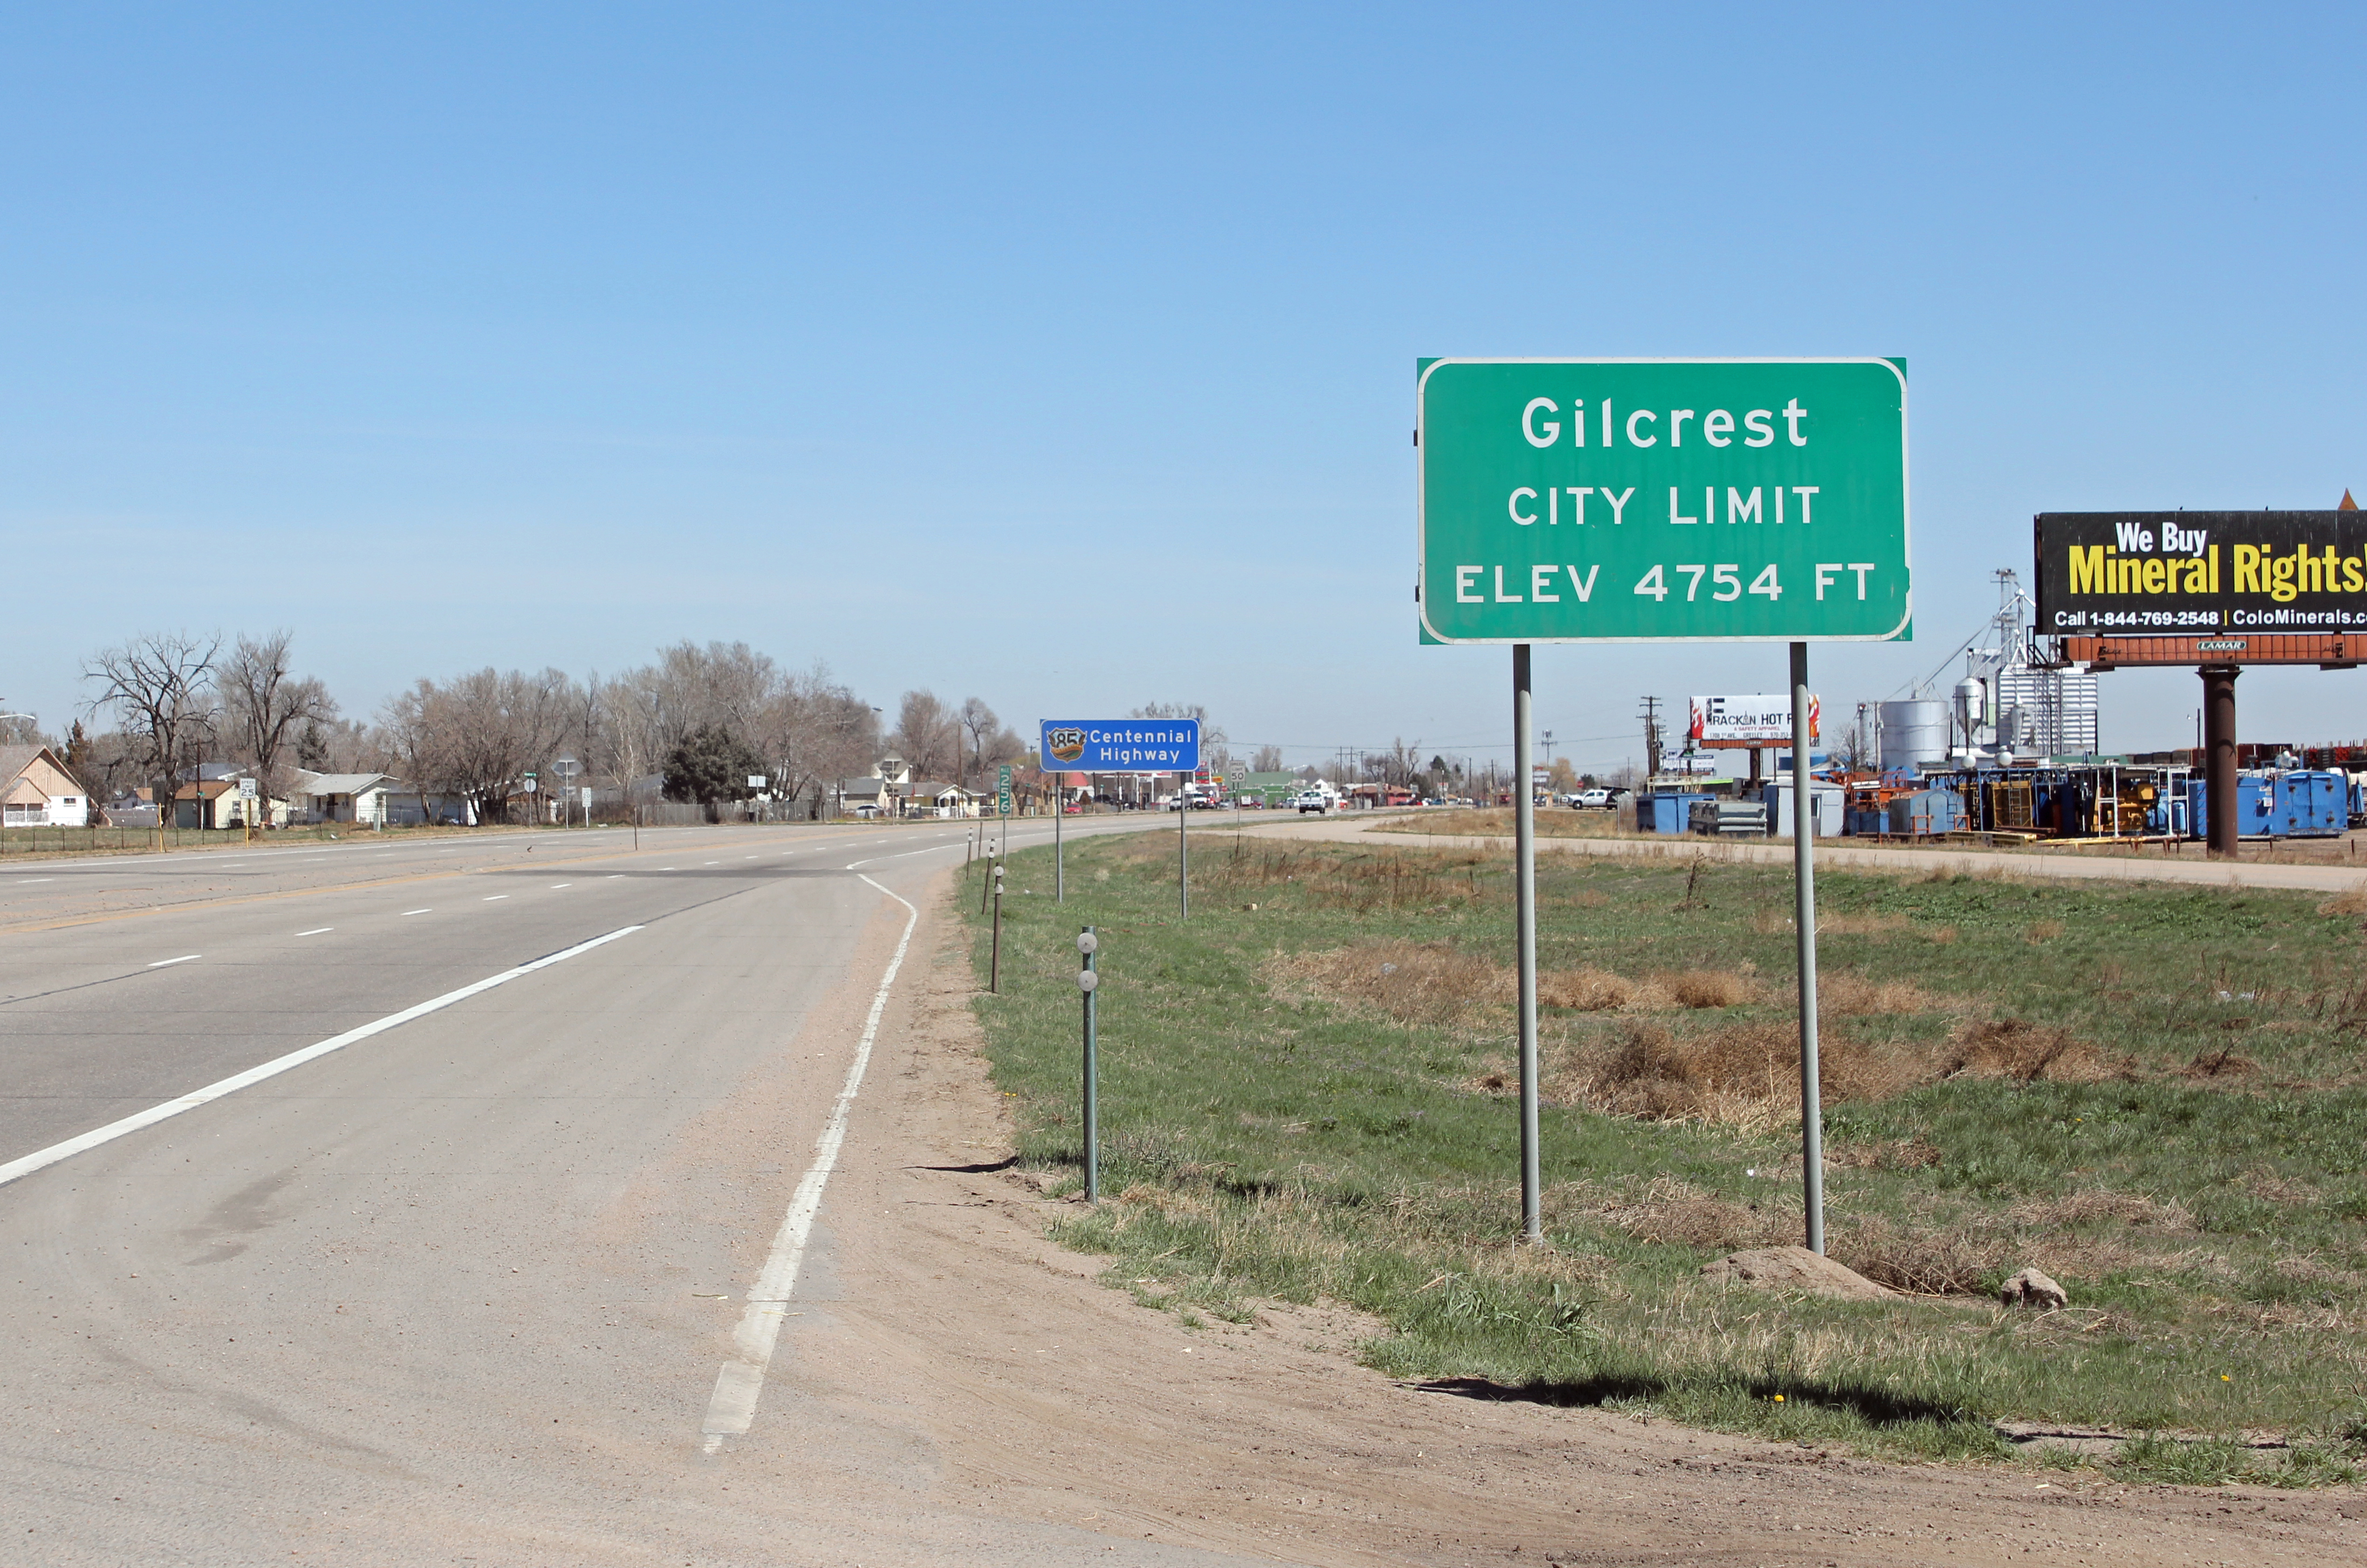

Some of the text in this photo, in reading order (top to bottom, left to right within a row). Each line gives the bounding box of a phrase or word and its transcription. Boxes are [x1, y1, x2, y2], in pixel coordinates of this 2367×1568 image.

[1522, 397, 1808, 448] Gilcrest
[1508, 486, 1819, 526] CITY LIMIT
[2115, 521, 2208, 558] We Buy
[2068, 543, 2367, 602] Mineral Rights
[1455, 563, 1875, 604] ELEV 4754 FT
[2054, 611, 2219, 626] Call 1-844-769-2548
[2232, 608, 2367, 625] ColoMinerals.c
[2200, 641, 2242, 649] LAMAR
[1761, 713, 1783, 725] HOT
[1056, 729, 1191, 748] 85 Centennial
[1100, 748, 1180, 765] Highway
[241, 788, 255, 797] 25
